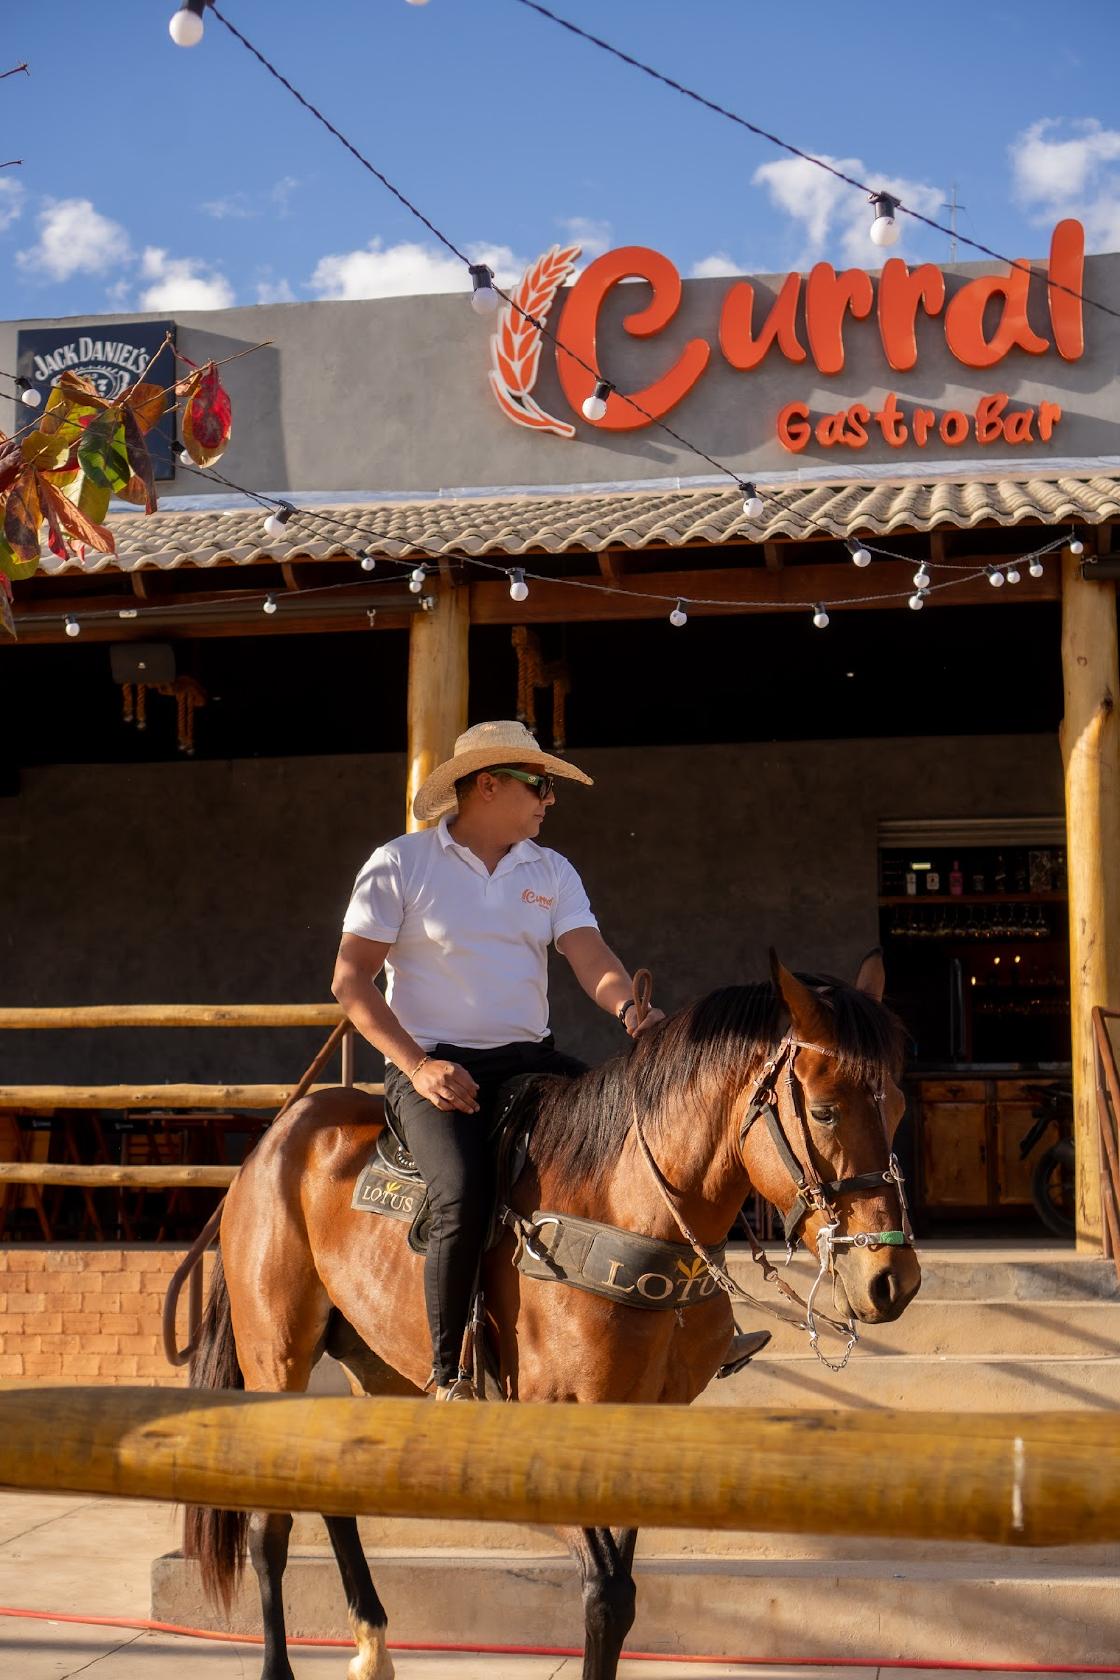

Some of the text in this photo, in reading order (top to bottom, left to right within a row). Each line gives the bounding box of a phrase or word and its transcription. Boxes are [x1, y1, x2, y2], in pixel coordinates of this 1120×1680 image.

[556, 219, 1085, 431] Curral
[34, 337, 150, 380] JACK DANIEL'S
[777, 392, 1062, 454] GastroBar
[362, 1185, 414, 1213] LOTUS
[602, 1258, 727, 1301] LOTU
